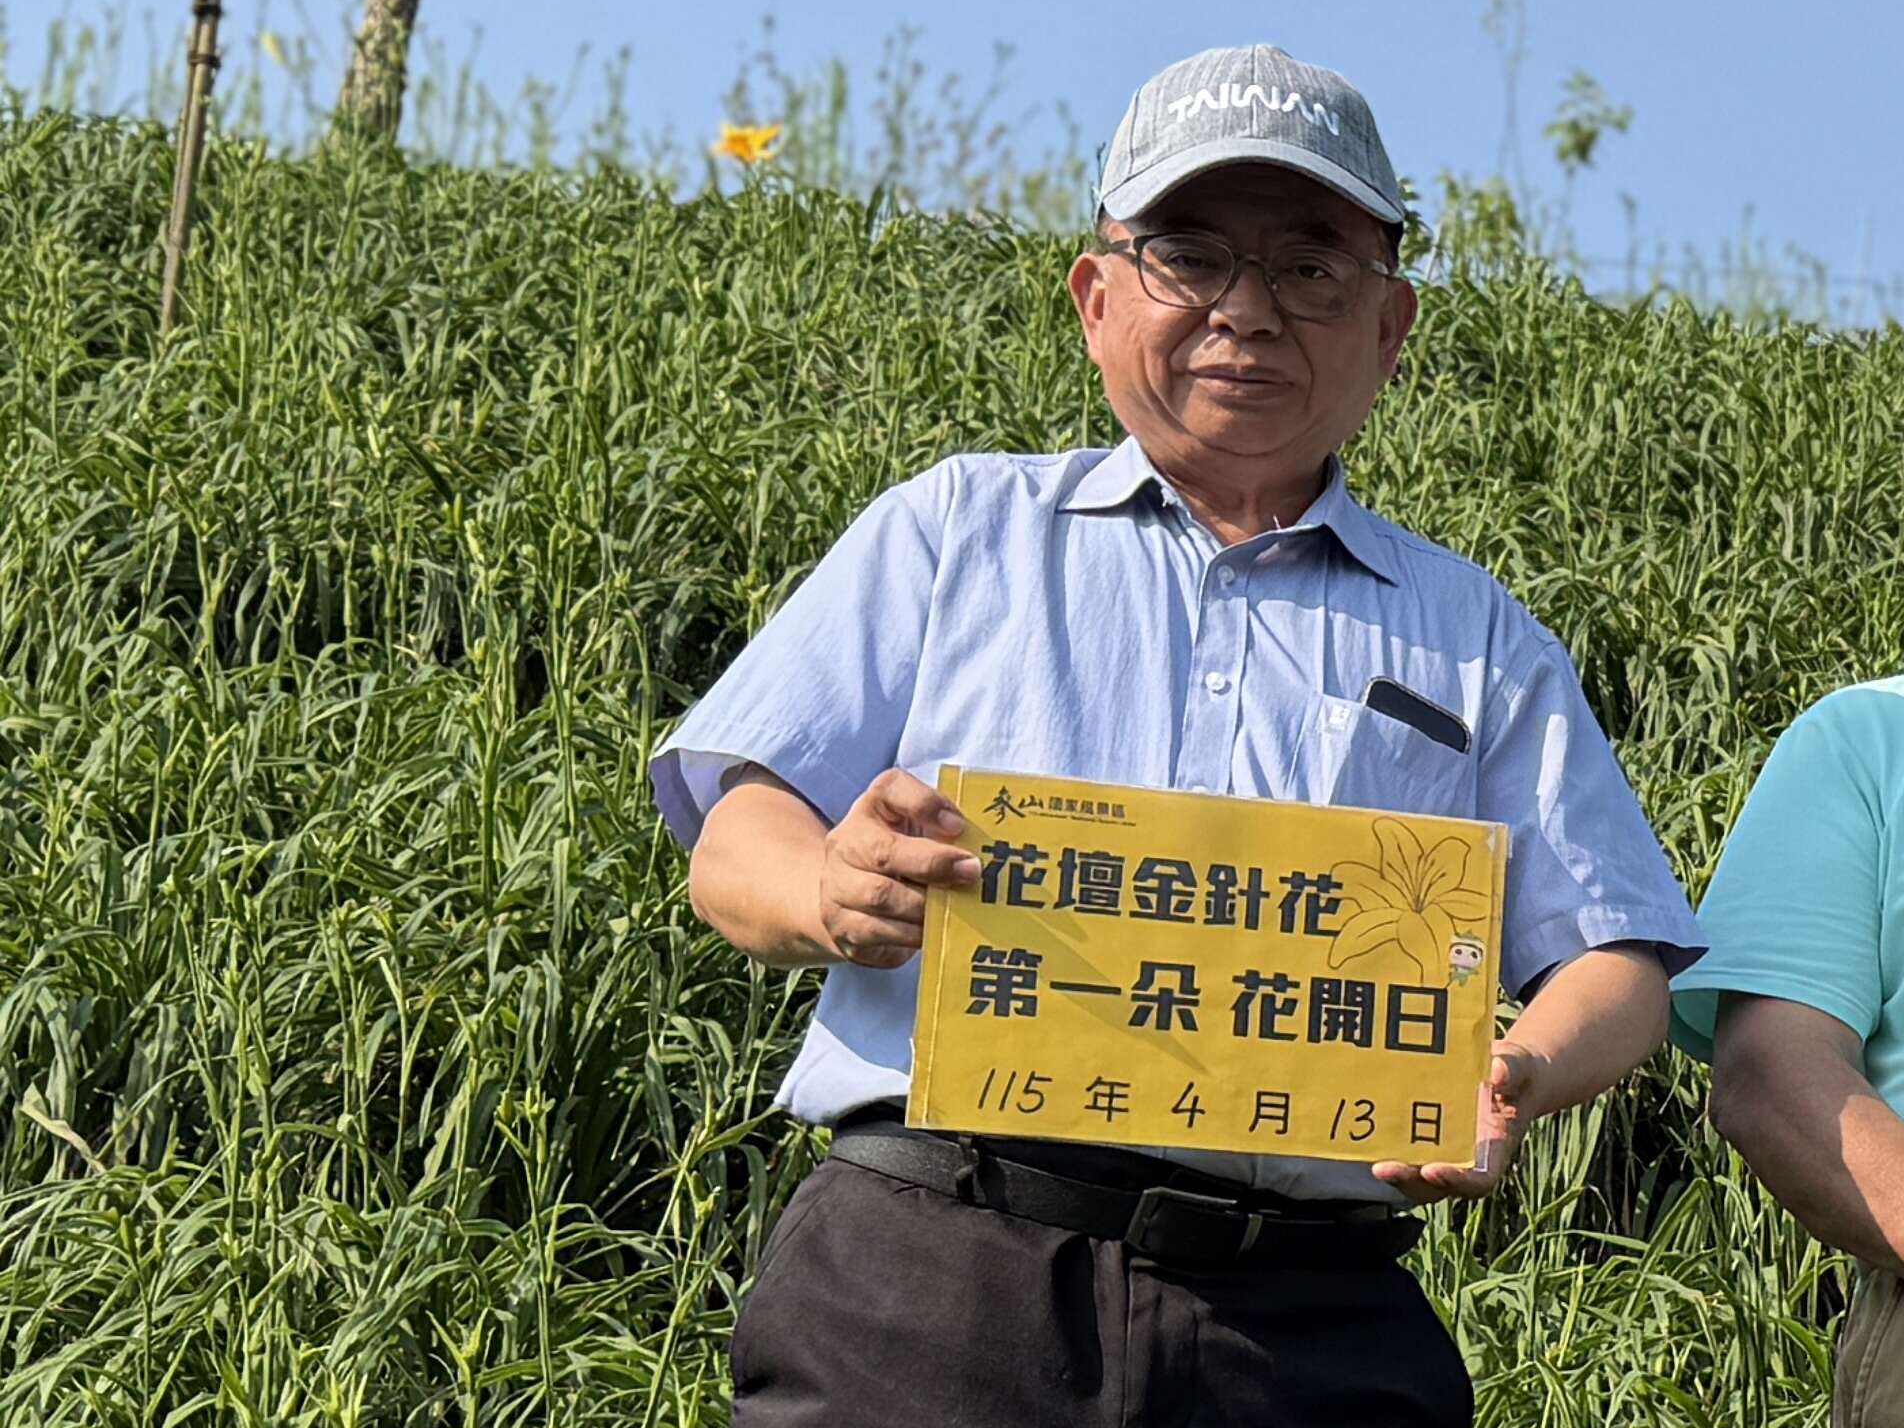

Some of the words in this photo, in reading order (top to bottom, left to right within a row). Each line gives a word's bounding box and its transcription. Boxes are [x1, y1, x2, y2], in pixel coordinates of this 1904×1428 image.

[1168, 82, 1340, 136] TAIWAN
[980, 839, 1344, 938] 花壇金針花
[964, 944, 1202, 1033] 第一朵
[1230, 968, 1450, 1055] 花開日
[977, 1066, 1054, 1114] 115
[1084, 1075, 1132, 1124] 年
[1170, 1080, 1207, 1129] 4
[1248, 1089, 1292, 1136] 月
[1329, 1097, 1377, 1143] 13
[1410, 1101, 1443, 1146] 日
